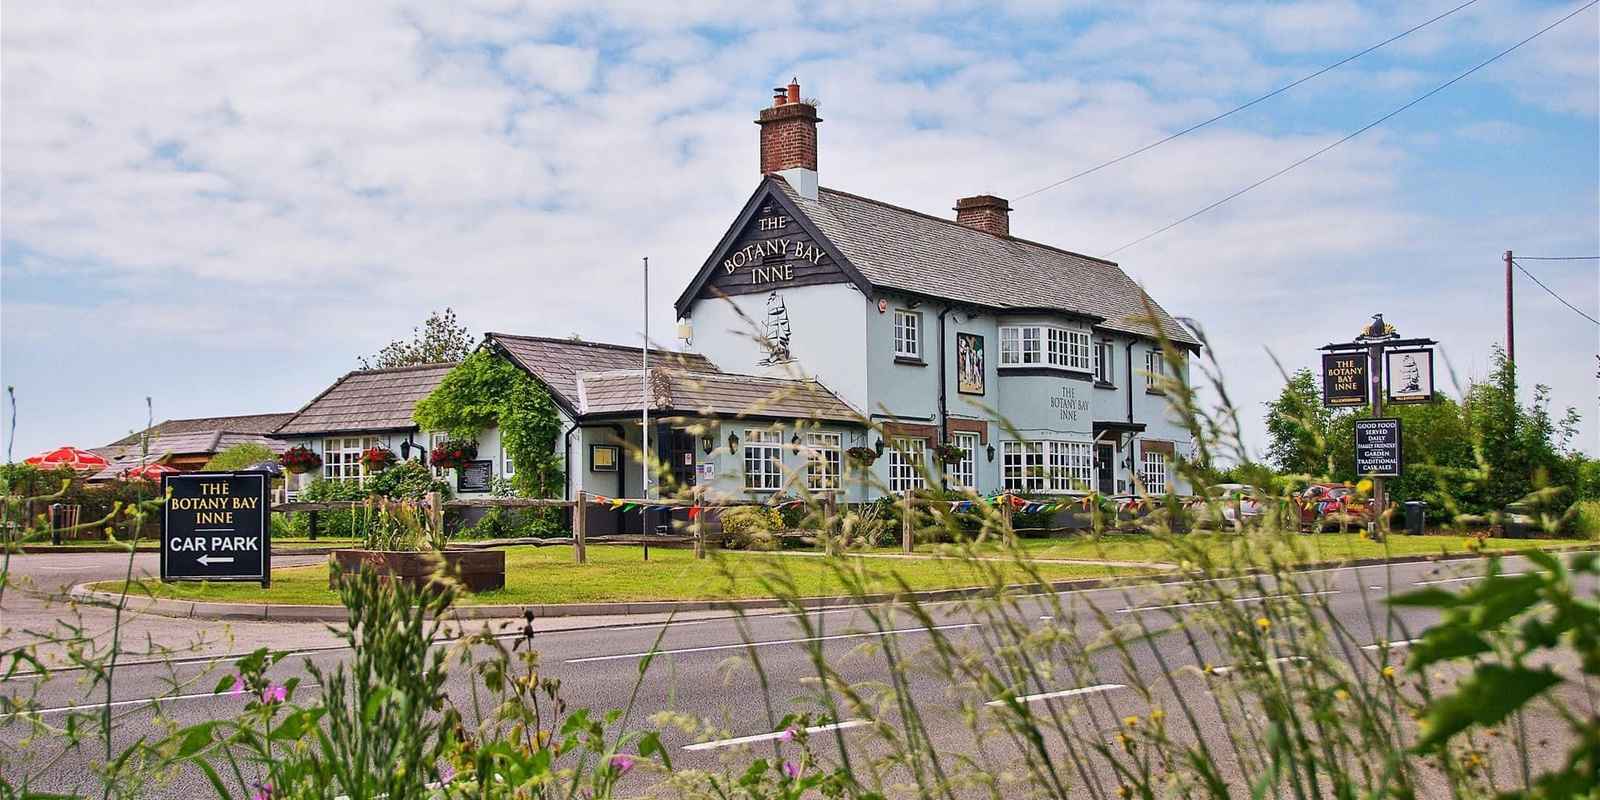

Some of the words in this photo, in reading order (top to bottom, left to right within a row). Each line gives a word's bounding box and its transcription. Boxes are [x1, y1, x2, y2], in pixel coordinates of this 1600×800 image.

[759, 216, 786, 231] THE
[724, 239, 790, 274] BOTANY
[795, 241, 826, 265] BAY
[752, 264, 794, 284] INNE
[1336, 360, 1355, 368] THE
[1328, 368, 1363, 377] BOTANY
[1338, 375, 1353, 383] BAY
[1062, 386, 1074, 398] THE
[1335, 382, 1358, 391] INNE
[1050, 396, 1077, 410] BOTANY
[1078, 400, 1089, 411] BAY
[1060, 409, 1077, 421] INNE
[200, 483, 229, 495] THE
[171, 498, 228, 509] BOTANY
[232, 497, 258, 509] BAY
[196, 512, 233, 524] INNE
[170, 537, 207, 551] CAR
[211, 537, 258, 551] PARK
